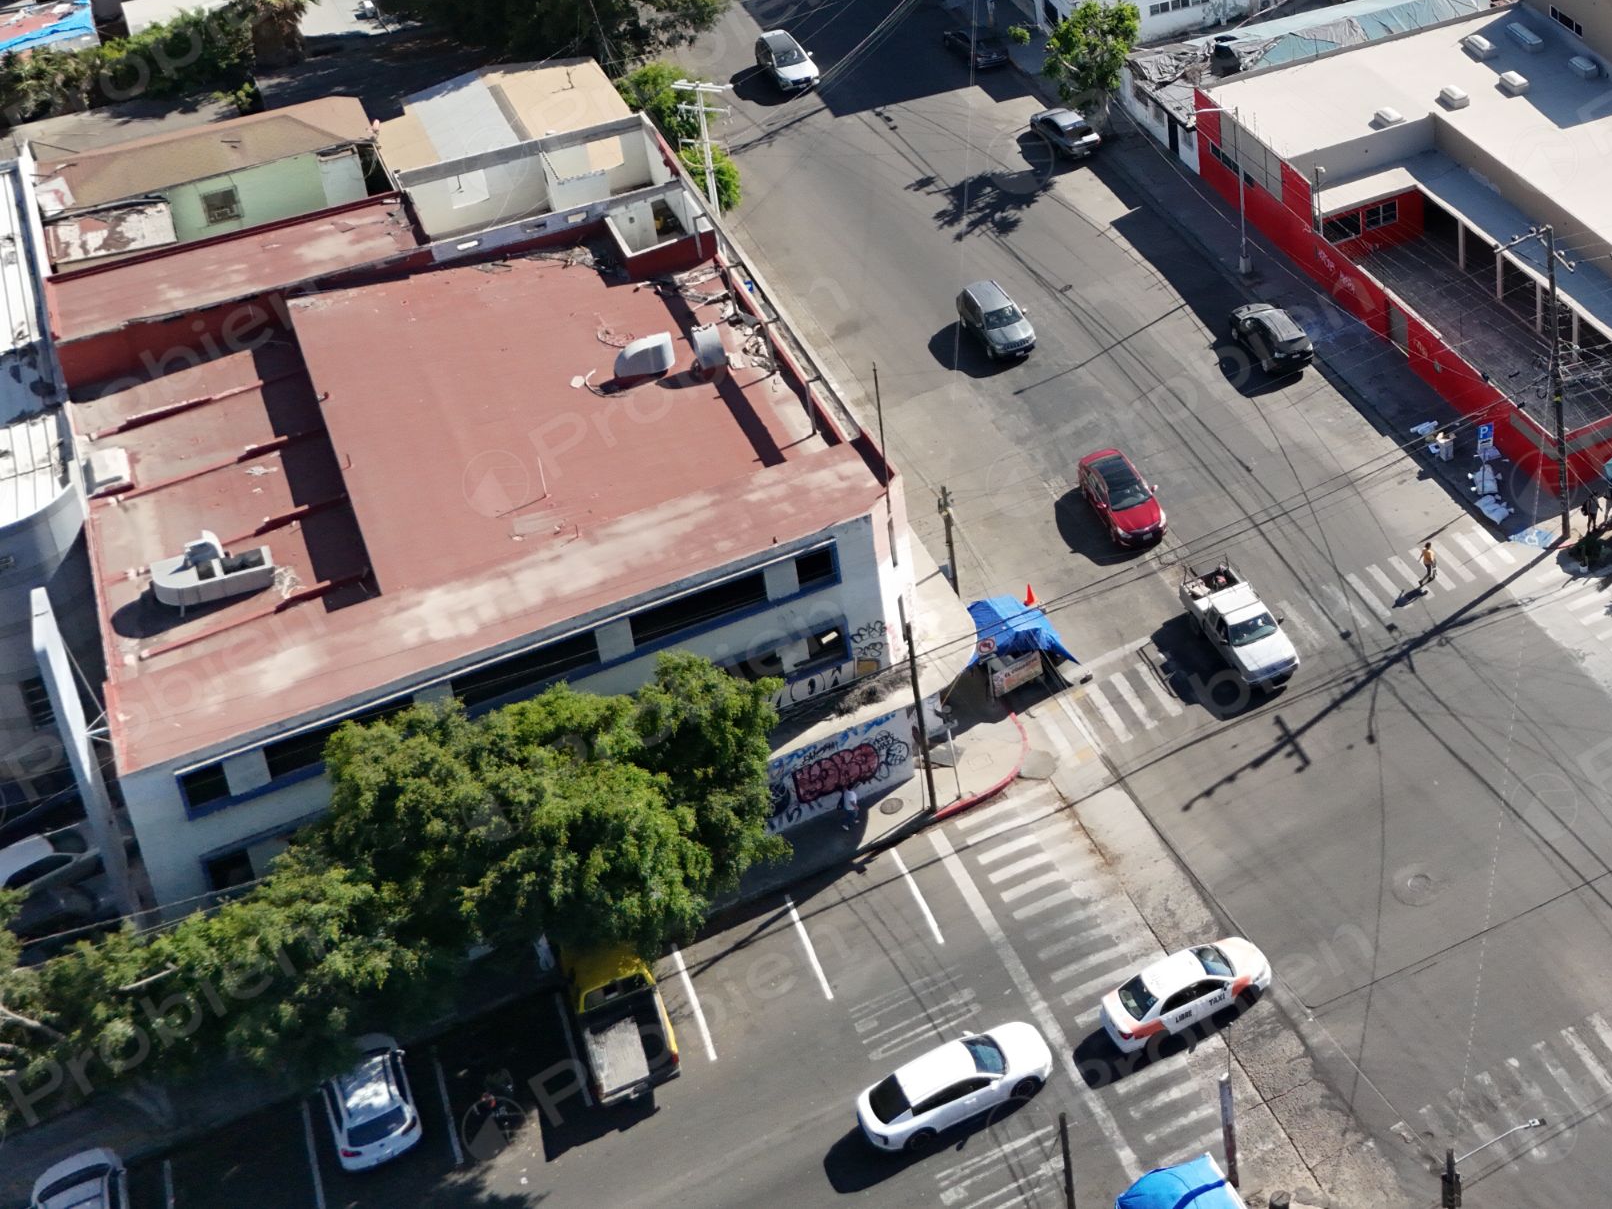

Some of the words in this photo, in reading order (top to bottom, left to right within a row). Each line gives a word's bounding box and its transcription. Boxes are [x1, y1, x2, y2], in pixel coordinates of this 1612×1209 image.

[1479, 426, 1488, 438] P
[1174, 1009, 1194, 1024] LIBRE
[1208, 992, 1226, 1006] TAXI
